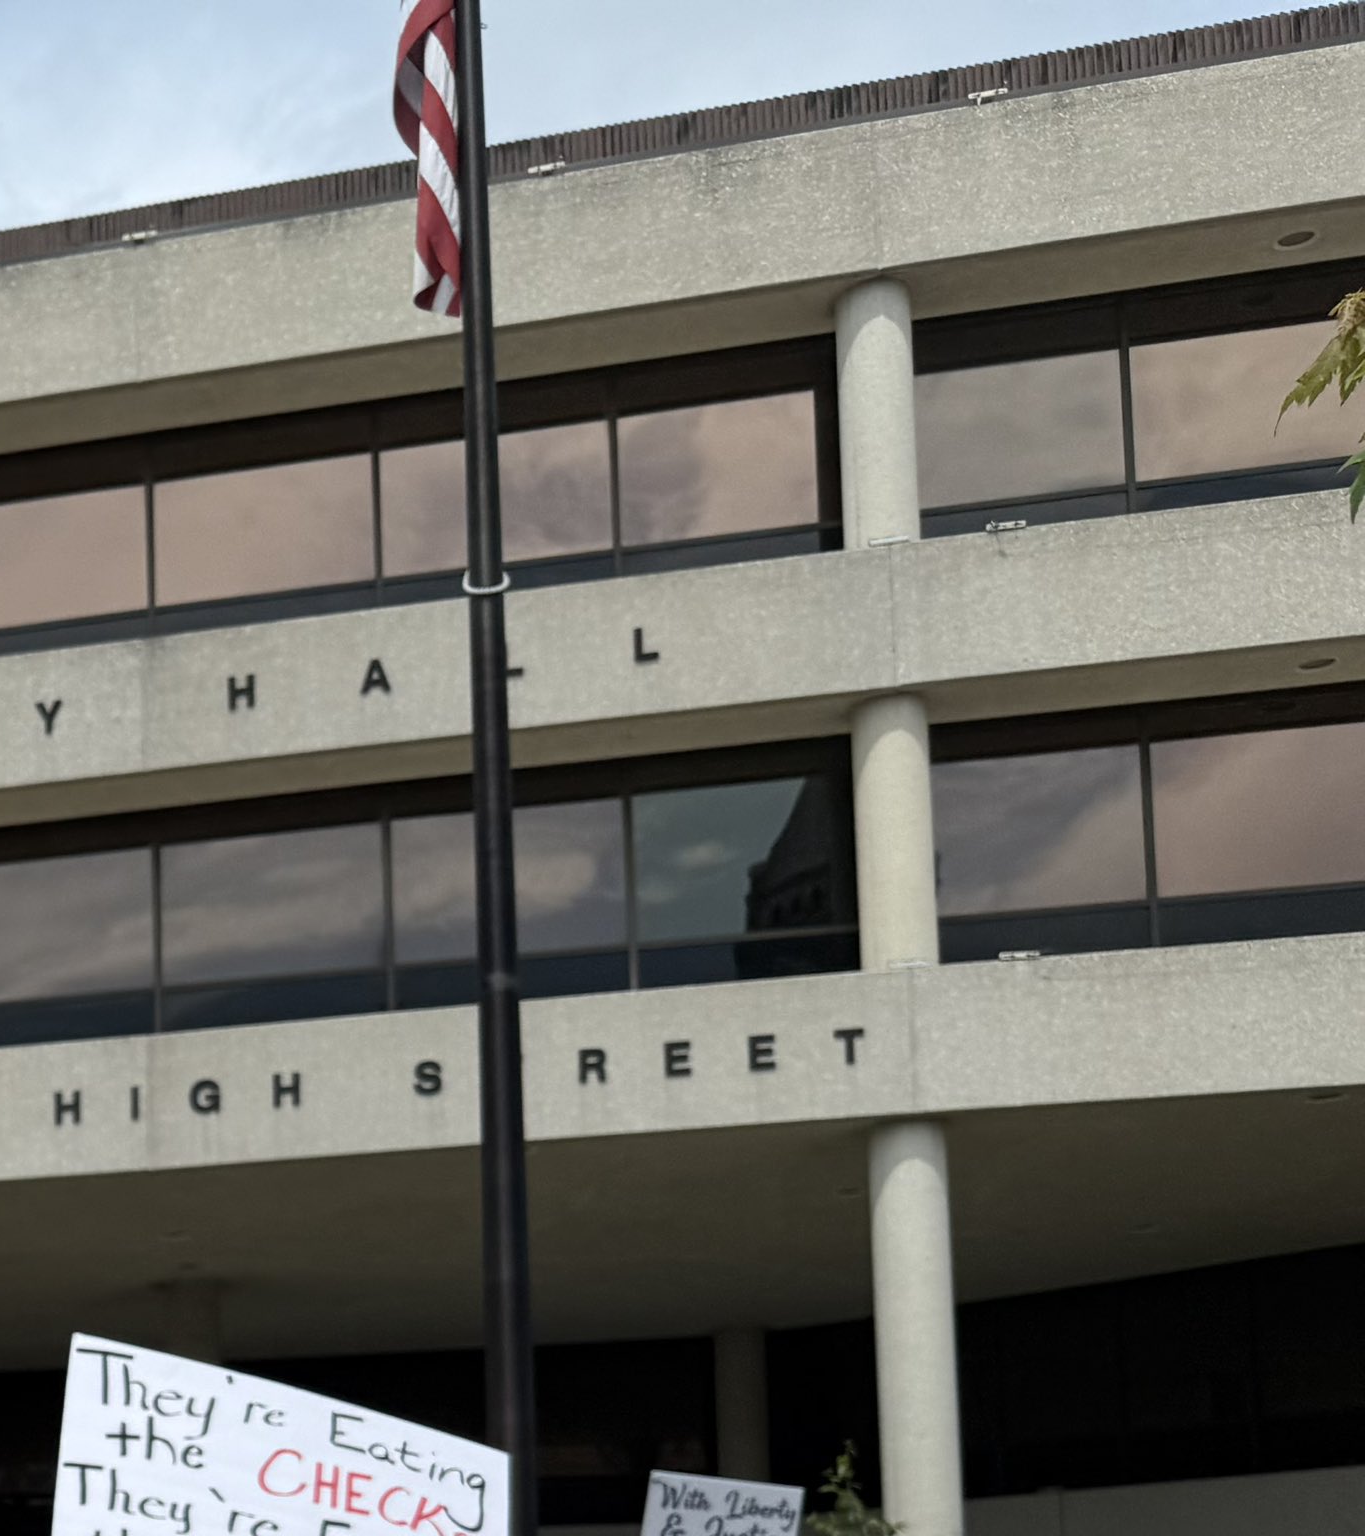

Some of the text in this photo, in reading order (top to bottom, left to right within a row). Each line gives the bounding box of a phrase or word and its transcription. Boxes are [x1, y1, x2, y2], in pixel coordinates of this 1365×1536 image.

[227, 626, 659, 712] HAL
[54, 1070, 303, 1127] HIGH
[413, 1027, 866, 1098] SREET
[75, 1347, 486, 1533] They're Eating
[105, 1415, 206, 1470] the
[652, 1478, 797, 1533] With Liberty
